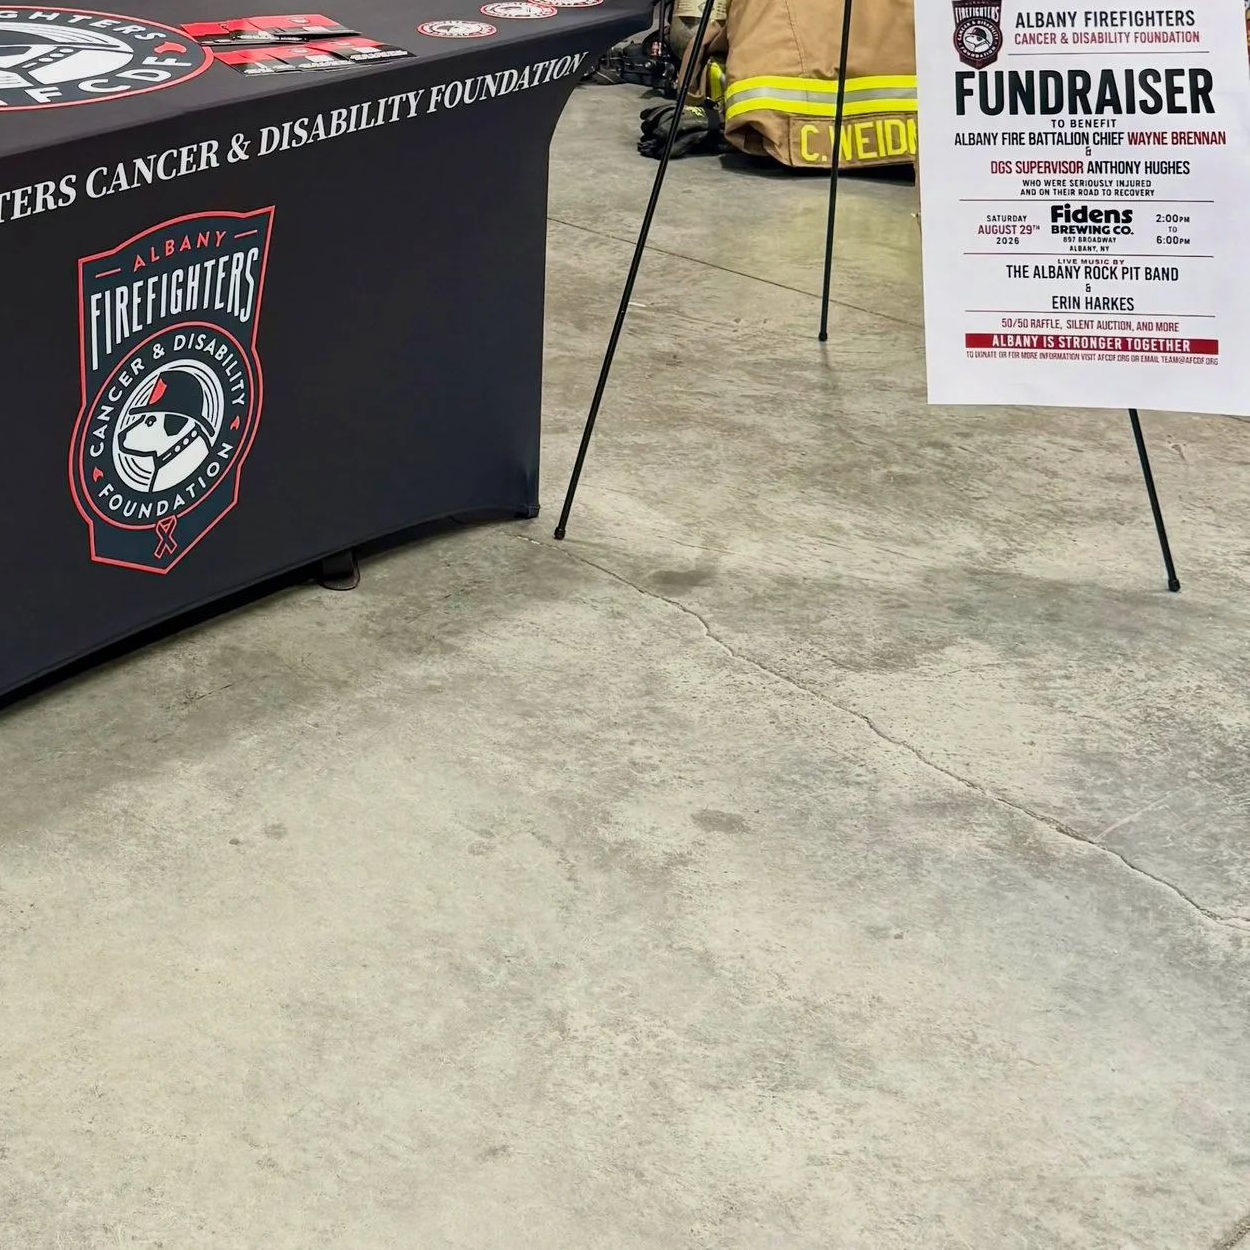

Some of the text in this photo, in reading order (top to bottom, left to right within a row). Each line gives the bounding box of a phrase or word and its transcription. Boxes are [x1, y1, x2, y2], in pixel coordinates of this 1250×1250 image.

[954, 68, 1216, 116] FUNDRAISER
[85, 139, 221, 199] CANCER
[226, 133, 251, 164] &
[259, 90, 425, 156] DISABILITY
[426, 50, 589, 115] FOUNDATION
[1051, 203, 1133, 223] Fidens
[1052, 225, 1134, 235] BREWING CO.
[132, 230, 228, 273] ALBANY
[90, 247, 260, 370] FIREFIGHTERS
[1052, 296, 1134, 311] ERIN HARKES
[90, 332, 245, 458] CANCER & DISABILITY
[97, 442, 234, 519] FOUNDATION
